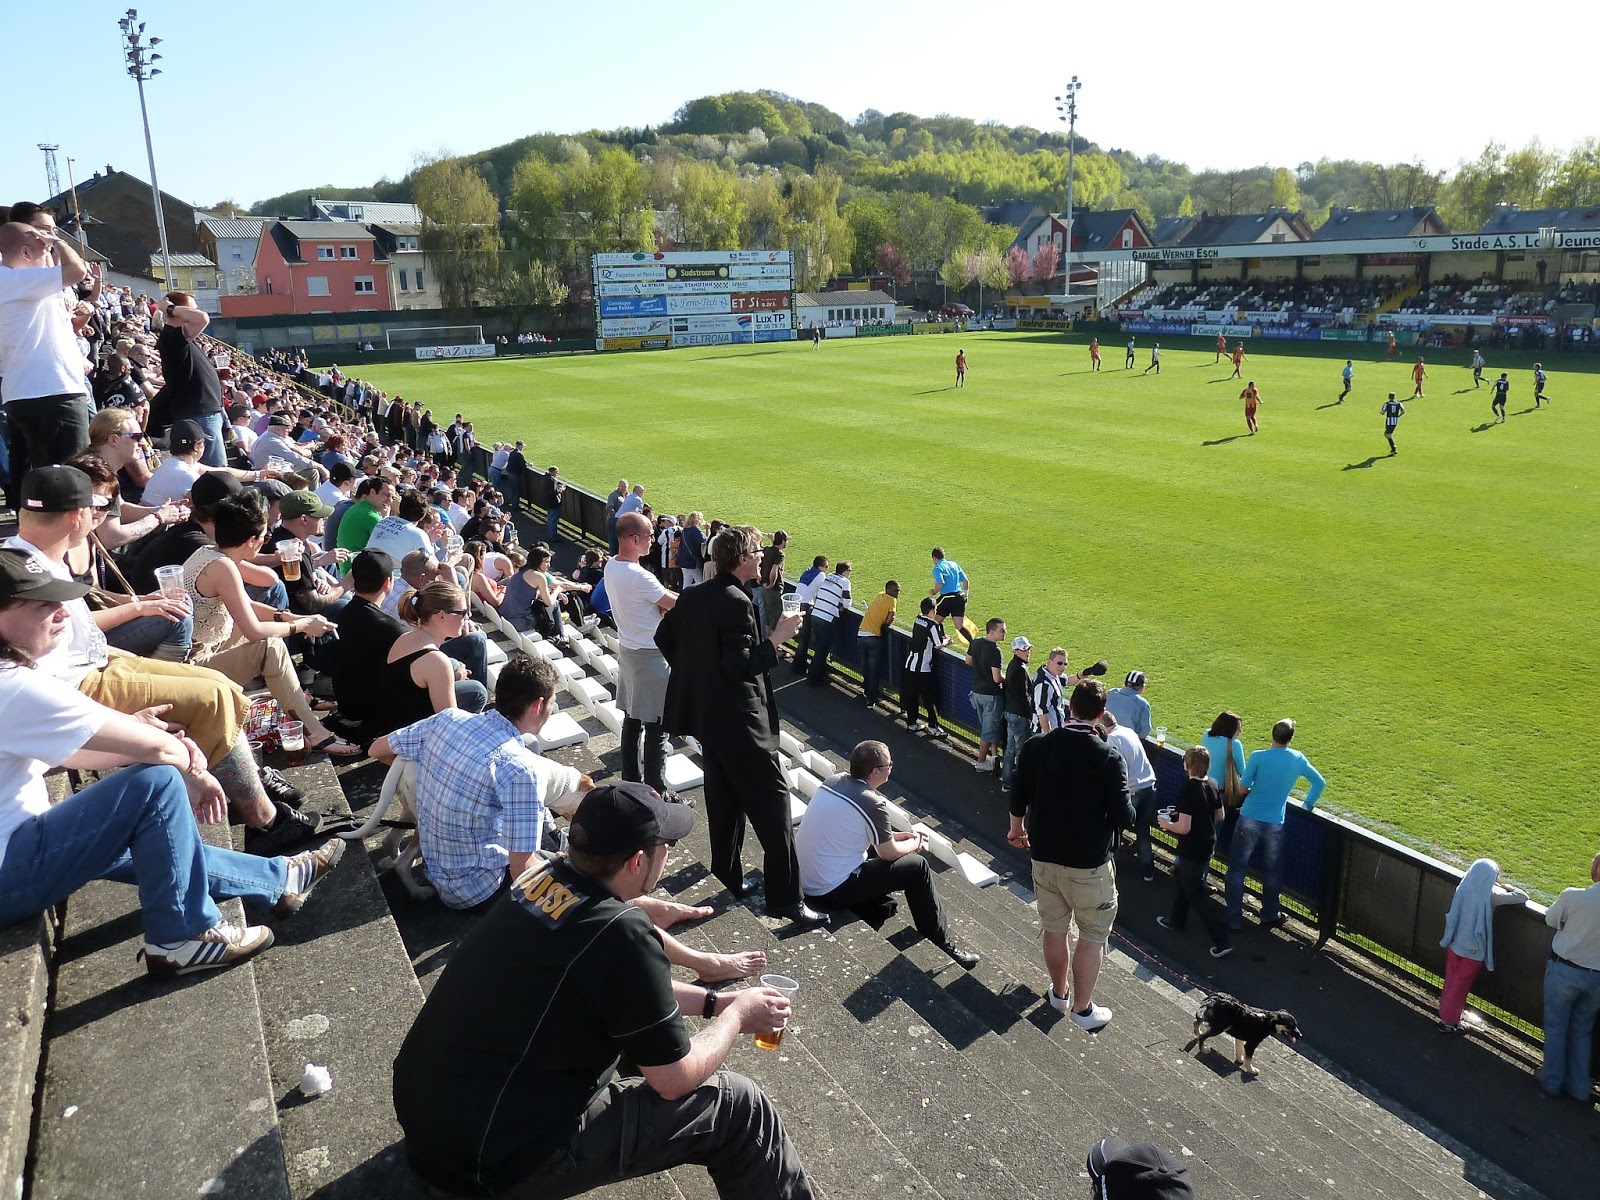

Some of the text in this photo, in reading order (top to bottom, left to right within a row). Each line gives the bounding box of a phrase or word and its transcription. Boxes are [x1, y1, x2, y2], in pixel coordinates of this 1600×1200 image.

[1451, 236, 1489, 250] Stade
[1493, 235, 1520, 249] A.S.
[1132, 248, 1219, 259] GARAGE WERNER ESCH
[680, 269, 716, 277] Sudstroum
[731, 298, 746, 309] ET
[755, 313, 785, 323] Lux TP
[1198, 327, 1250, 336] Cactus Cactus
[689, 334, 730, 344] ELTRONA
[419, 346, 475, 357] LUXAZAR
